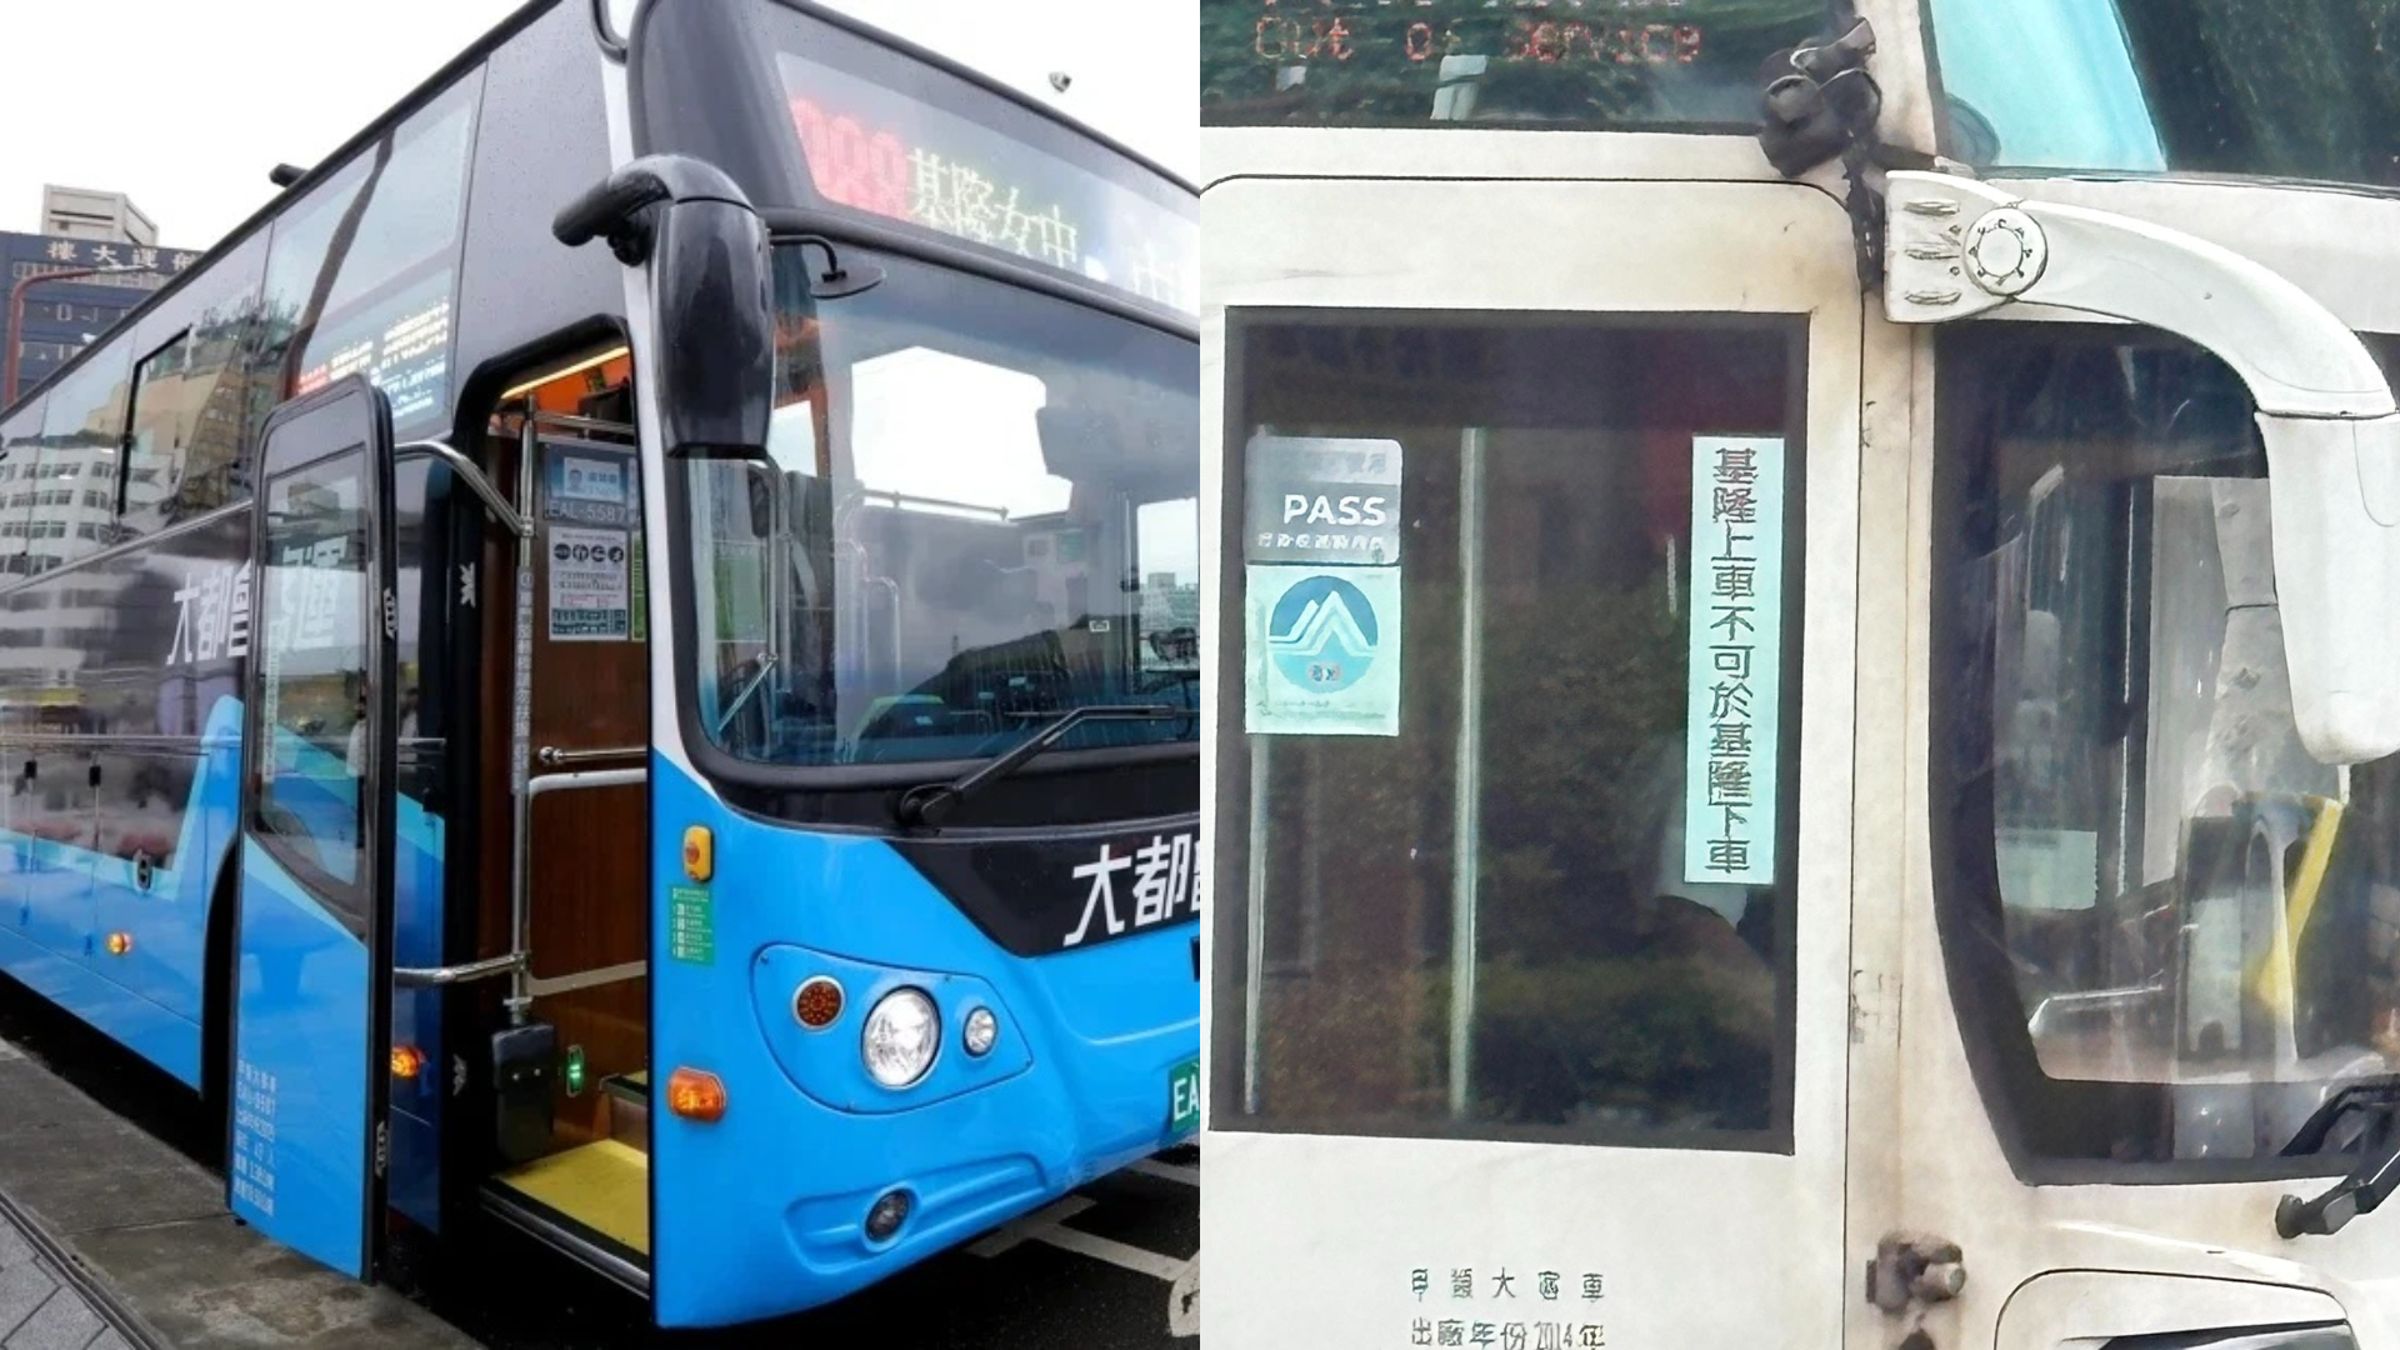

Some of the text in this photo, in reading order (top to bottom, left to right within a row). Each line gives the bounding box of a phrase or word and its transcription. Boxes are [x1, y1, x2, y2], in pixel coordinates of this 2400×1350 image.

[1283, 494, 1387, 527] PASS
[1705, 448, 1758, 874] 基隆上車不可於基隆下車
[1063, 833, 1200, 947] 大都
